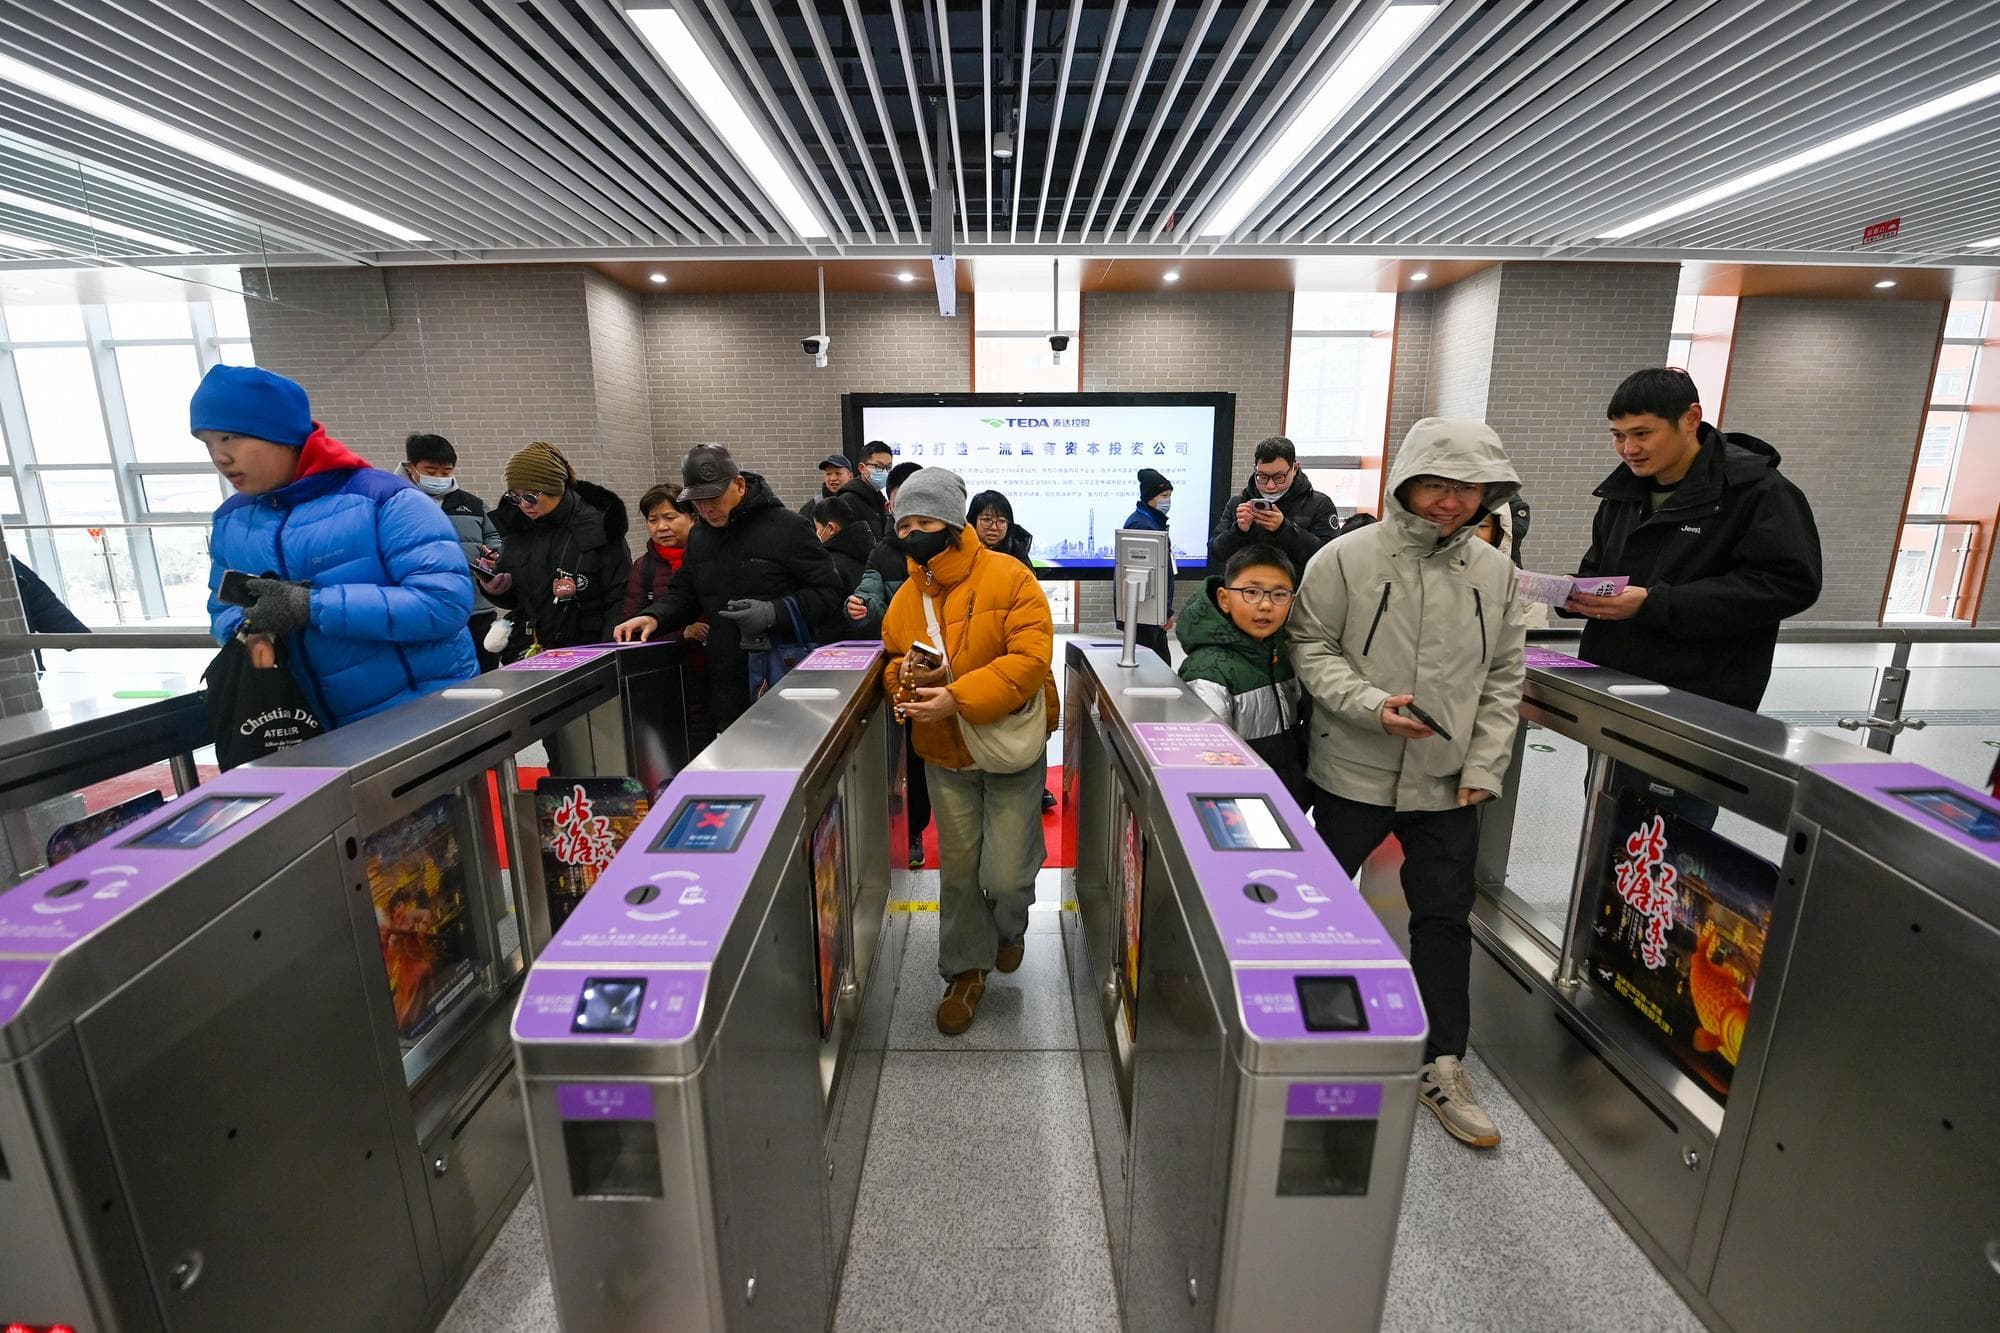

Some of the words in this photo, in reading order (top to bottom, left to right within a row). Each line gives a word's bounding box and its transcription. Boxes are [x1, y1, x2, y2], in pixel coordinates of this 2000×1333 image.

[1006, 418, 1049, 428] TEDA
[1053, 418, 1090, 428] 泰达控股
[1681, 525, 1701, 534] Jeep
